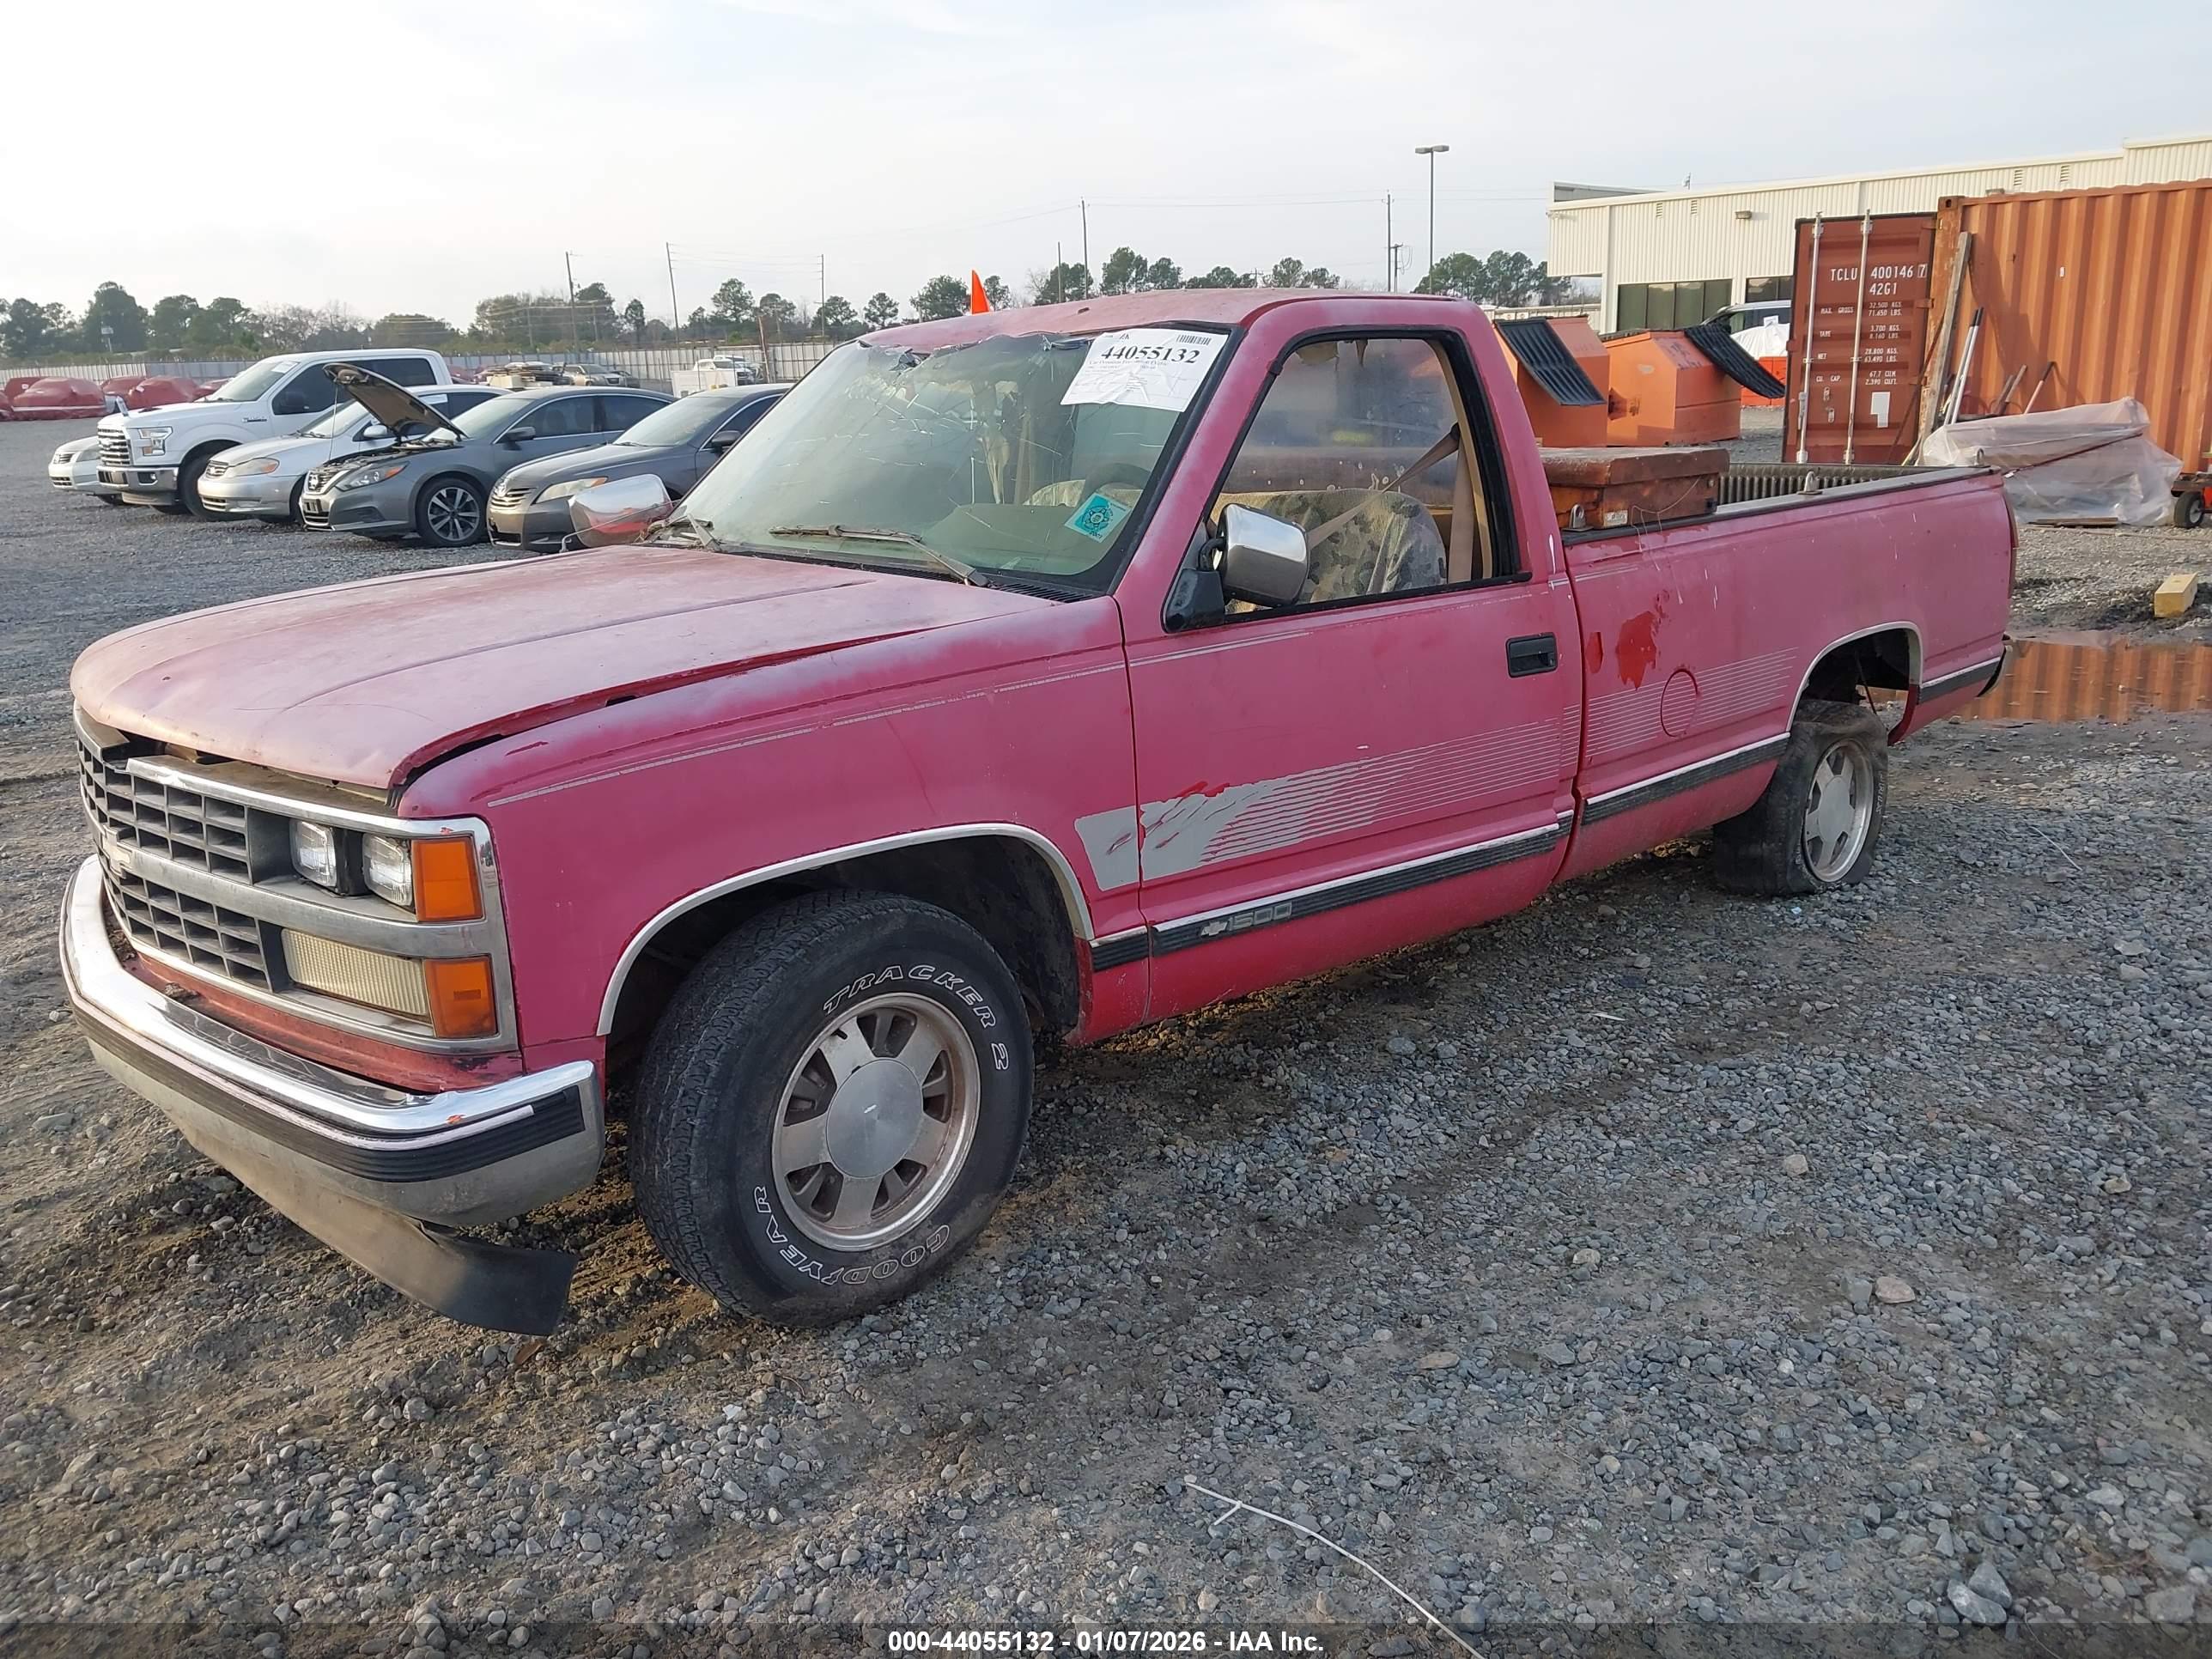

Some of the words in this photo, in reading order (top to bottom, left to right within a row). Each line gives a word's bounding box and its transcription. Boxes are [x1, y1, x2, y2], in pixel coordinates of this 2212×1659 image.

[1831, 267, 1858, 281] TCLU
[1870, 265, 1914, 279] 400146
[1918, 264, 1927, 278] 7
[1869, 283, 1897, 295] 42G1
[1101, 345, 1200, 364] 44055132
[1228, 902, 1292, 931] 1500
[823, 964, 996, 1028] TRACKER
[991, 1042, 1009, 1071] 2
[754, 1186, 950, 1285] GOODYEAR
